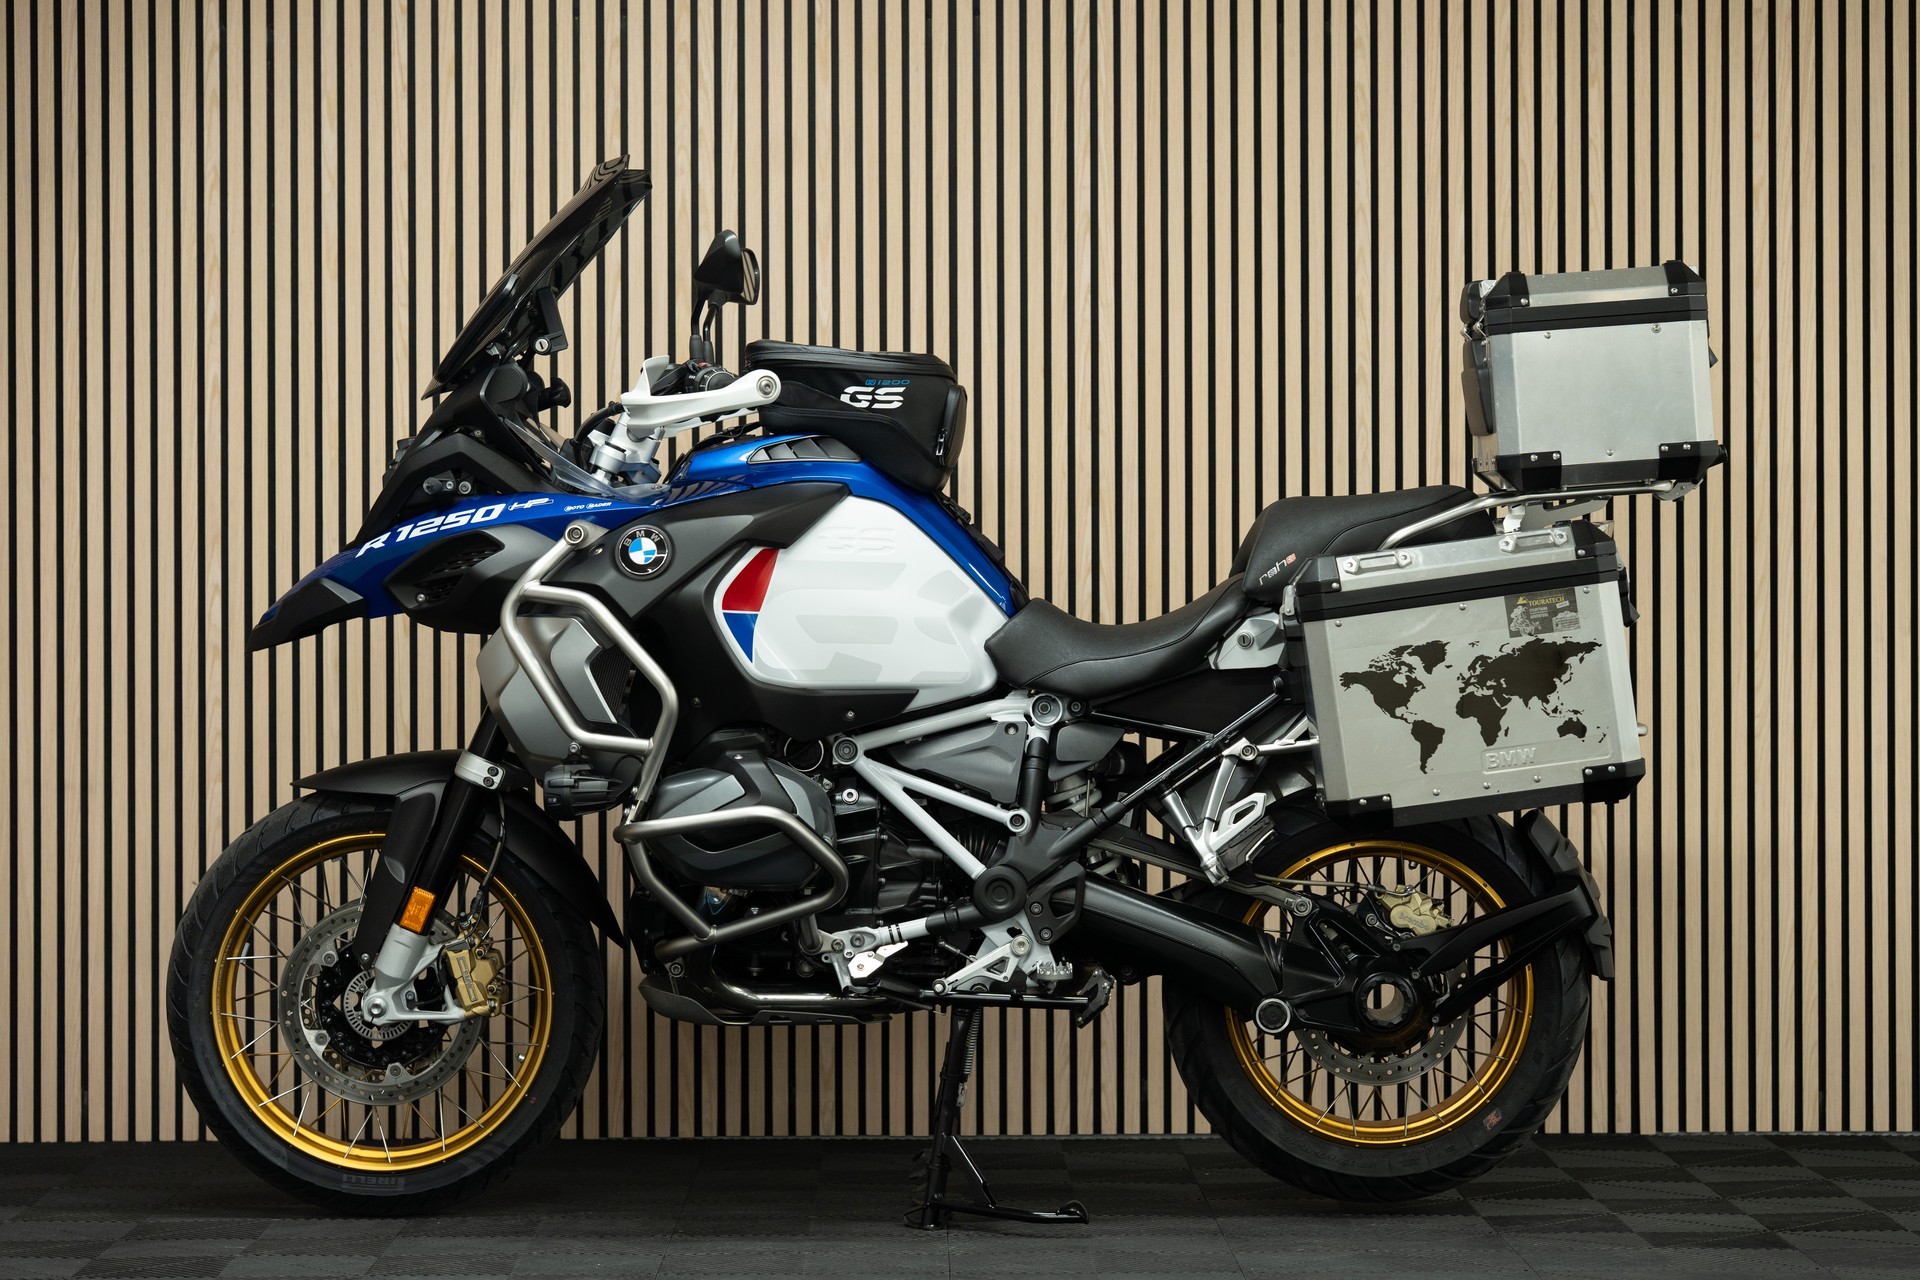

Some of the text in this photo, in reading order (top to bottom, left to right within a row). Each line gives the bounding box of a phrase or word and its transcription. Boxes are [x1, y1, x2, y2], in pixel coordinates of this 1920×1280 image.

[840, 385, 906, 409] GS
[396, 503, 506, 543] 1250
[623, 530, 660, 546] BMW
[1528, 596, 1565, 606] TOURATECH
[1486, 747, 1536, 769] BMW
[341, 1174, 405, 1191] PIRELLI
